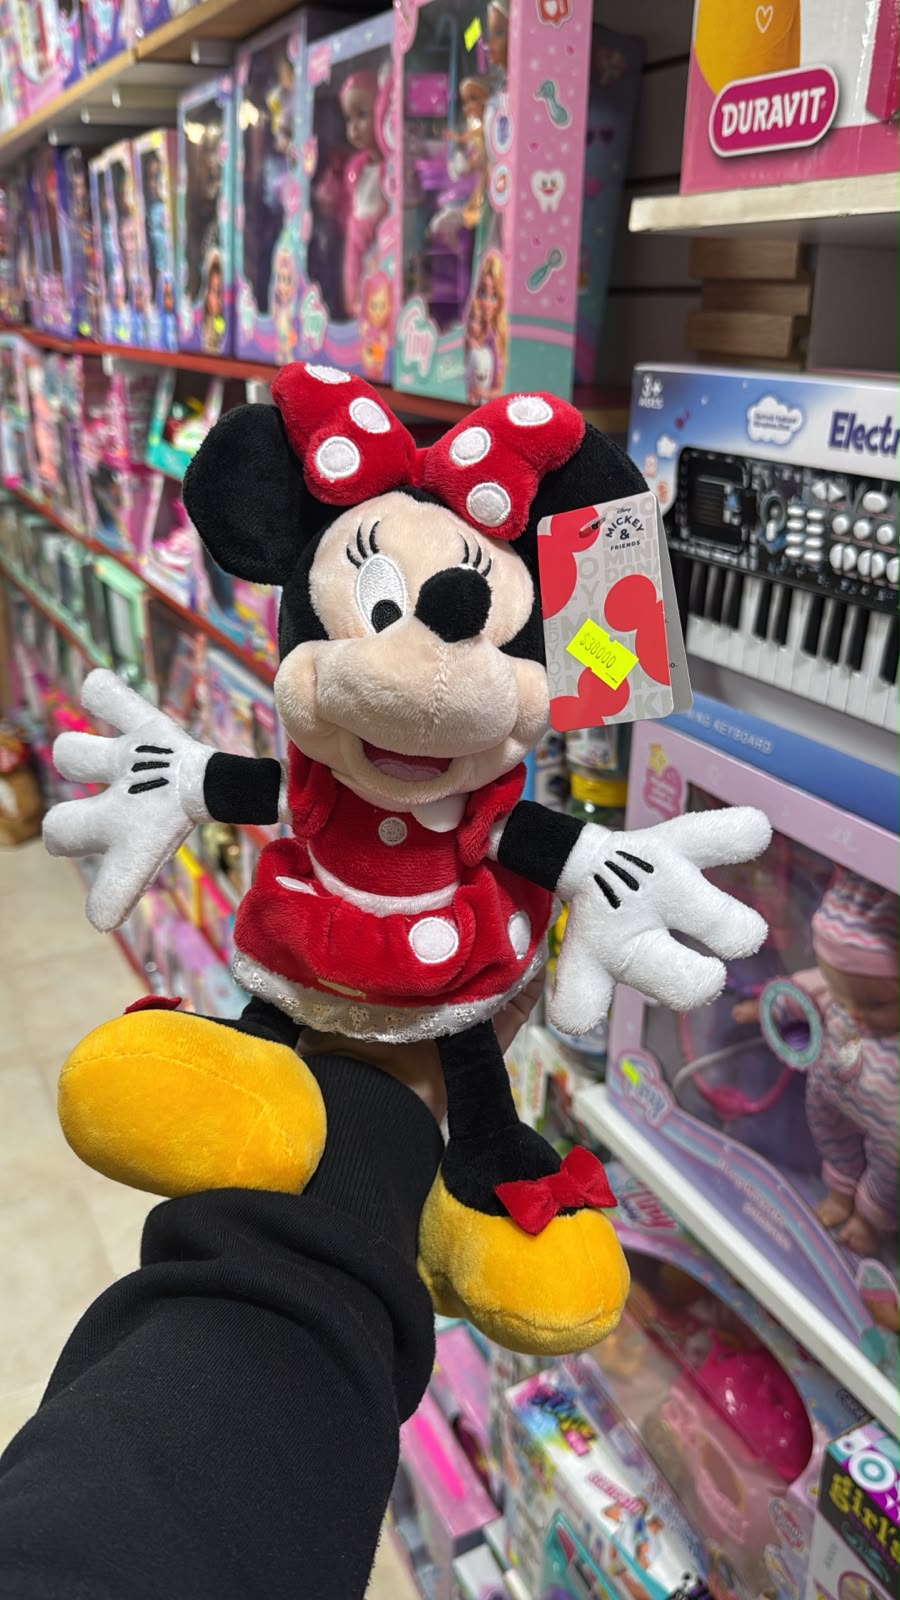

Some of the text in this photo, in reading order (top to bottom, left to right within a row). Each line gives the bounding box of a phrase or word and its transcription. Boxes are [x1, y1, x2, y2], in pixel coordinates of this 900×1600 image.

[721, 86, 826, 138] DURAVIT
[605, 515, 645, 538] MICKEY
[619, 528, 630, 540] &
[610, 540, 641, 551] FRIENDS
[579, 632, 617, 669] $38000
